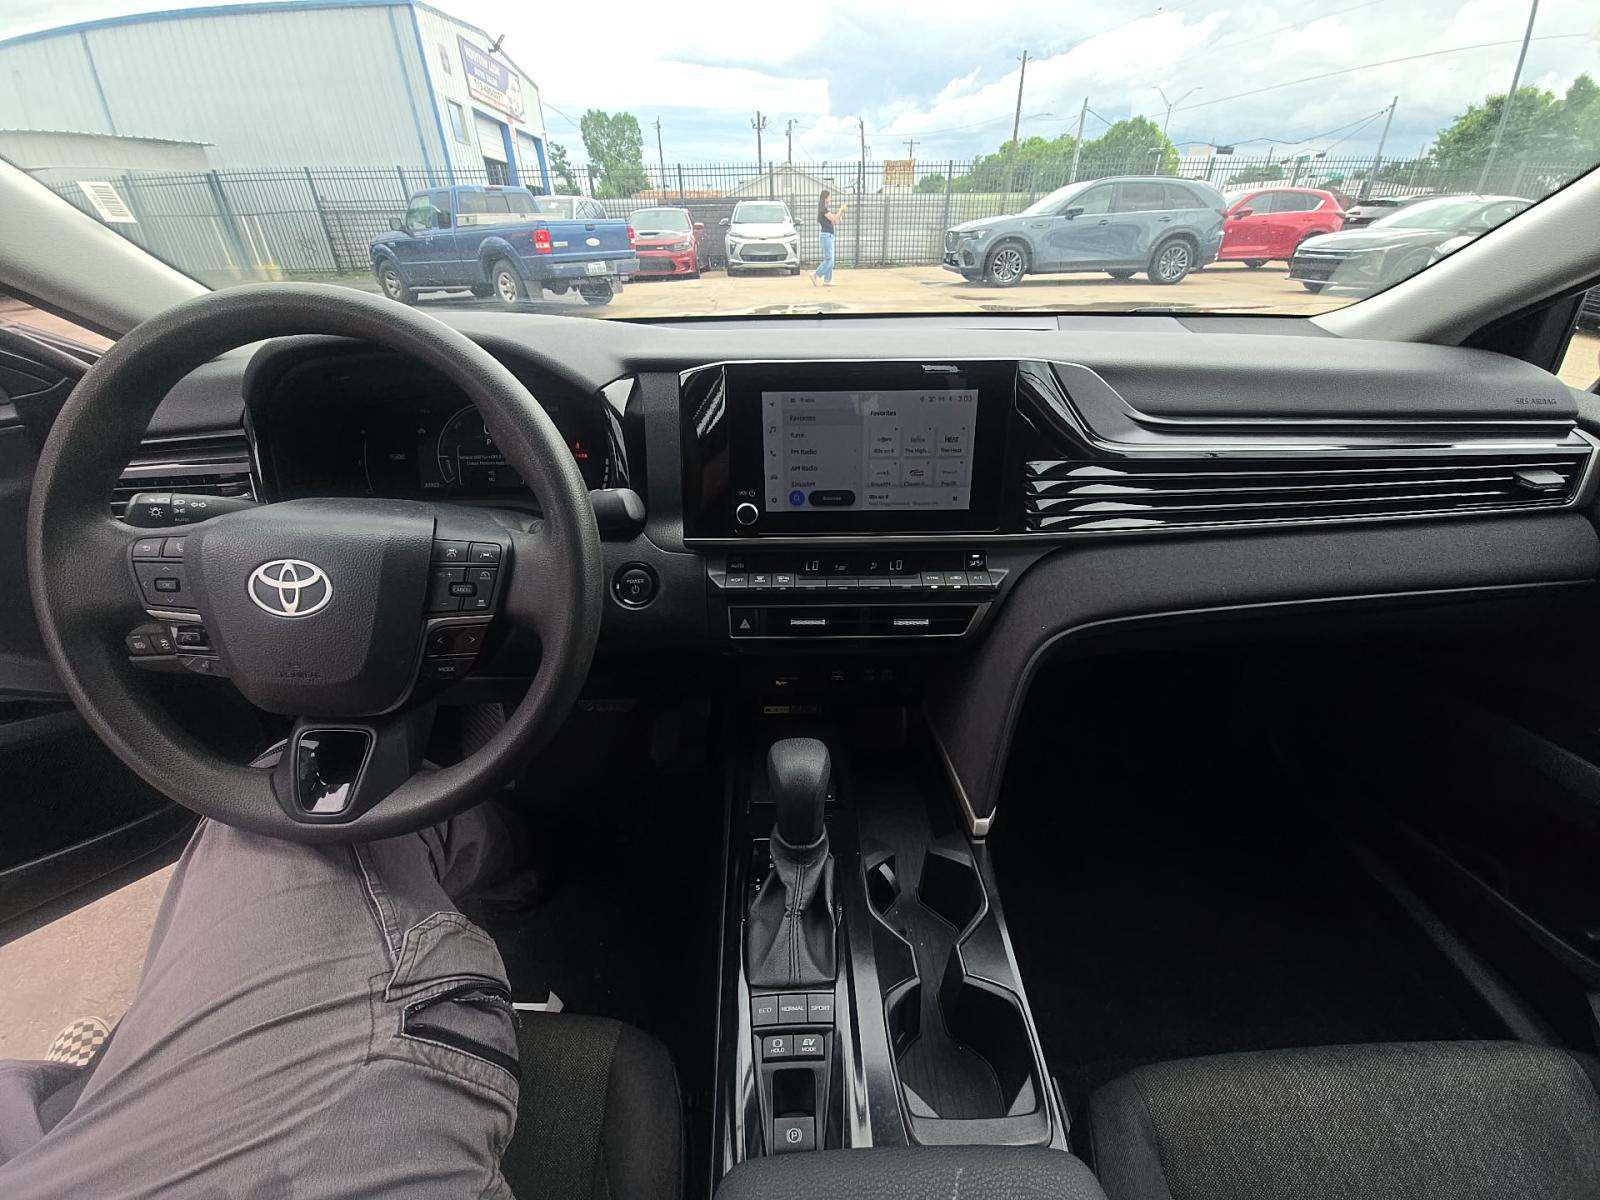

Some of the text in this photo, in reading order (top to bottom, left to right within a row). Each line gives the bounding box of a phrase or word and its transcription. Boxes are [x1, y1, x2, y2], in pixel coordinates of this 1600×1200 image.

[438, 665, 456, 673] MODE
[810, 1004, 830, 1012] SPORT
[802, 1038, 815, 1046] EV
